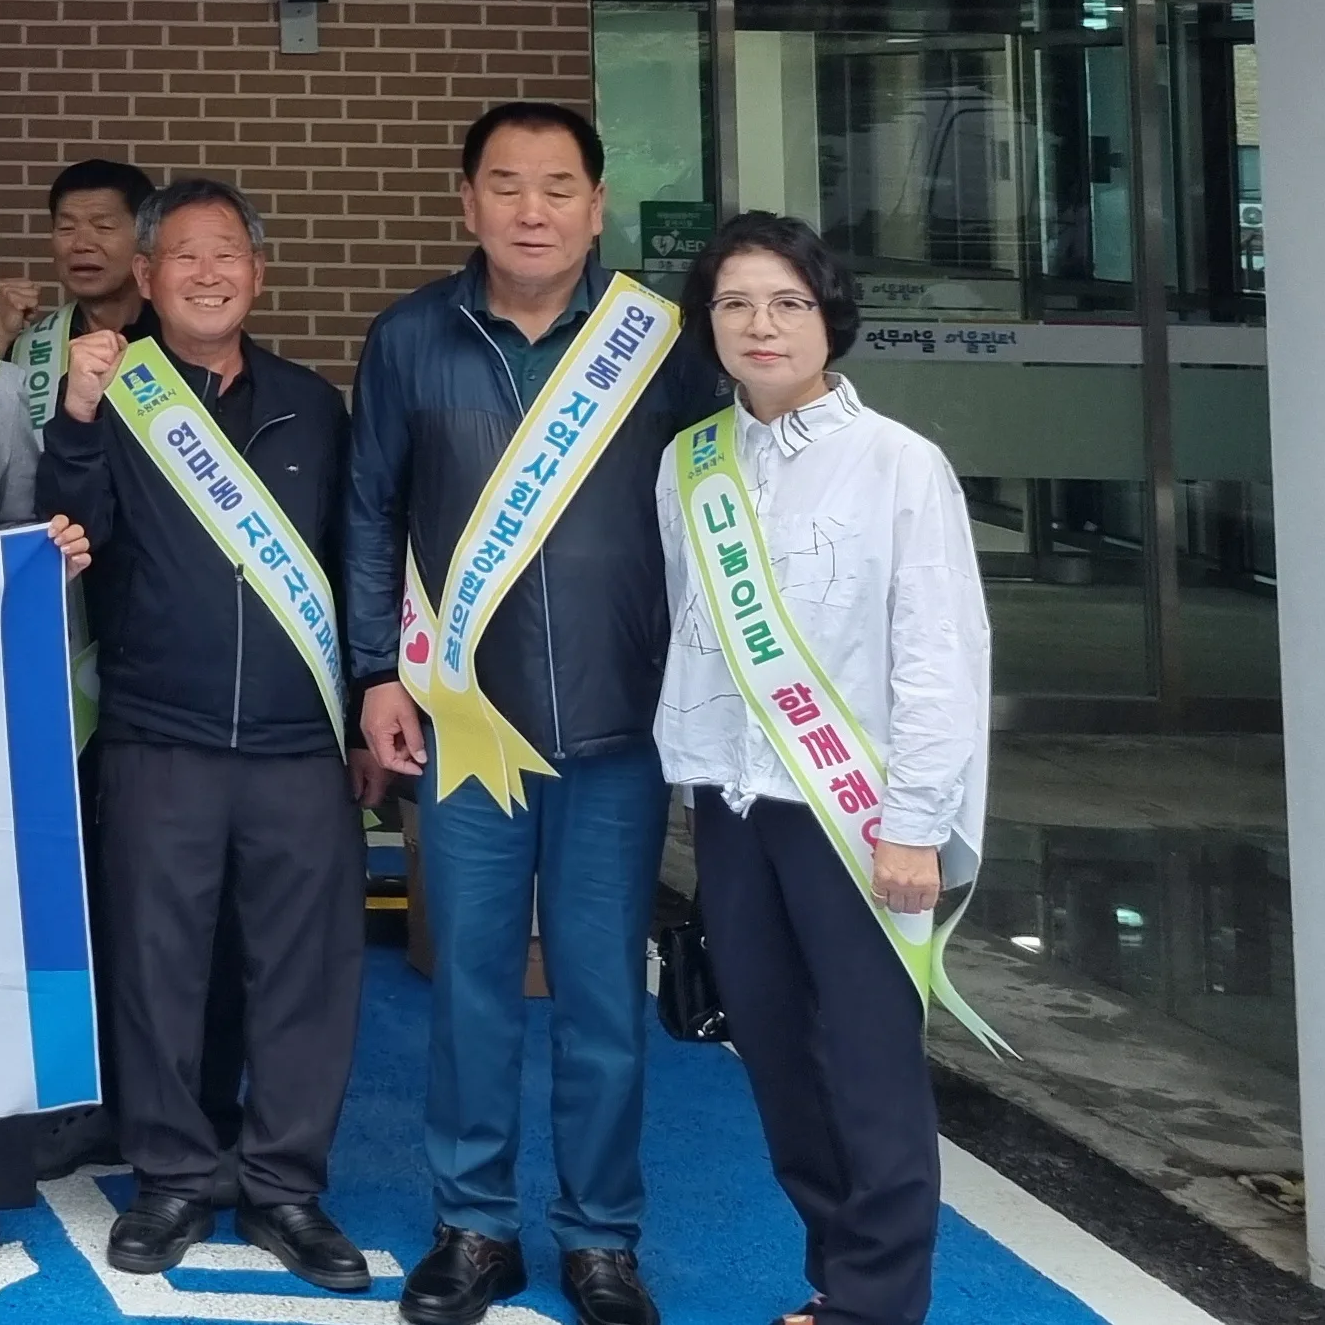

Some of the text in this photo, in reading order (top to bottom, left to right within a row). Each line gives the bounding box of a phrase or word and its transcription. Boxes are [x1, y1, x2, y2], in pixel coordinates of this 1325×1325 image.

[584, 304, 656, 392] 연무동
[865, 328, 1018, 355] 연무마을 어울림터
[166, 420, 244, 512] 연무동
[443, 390, 600, 674] 지역사회보장협의체
[701, 492, 786, 666] 나눔으로
